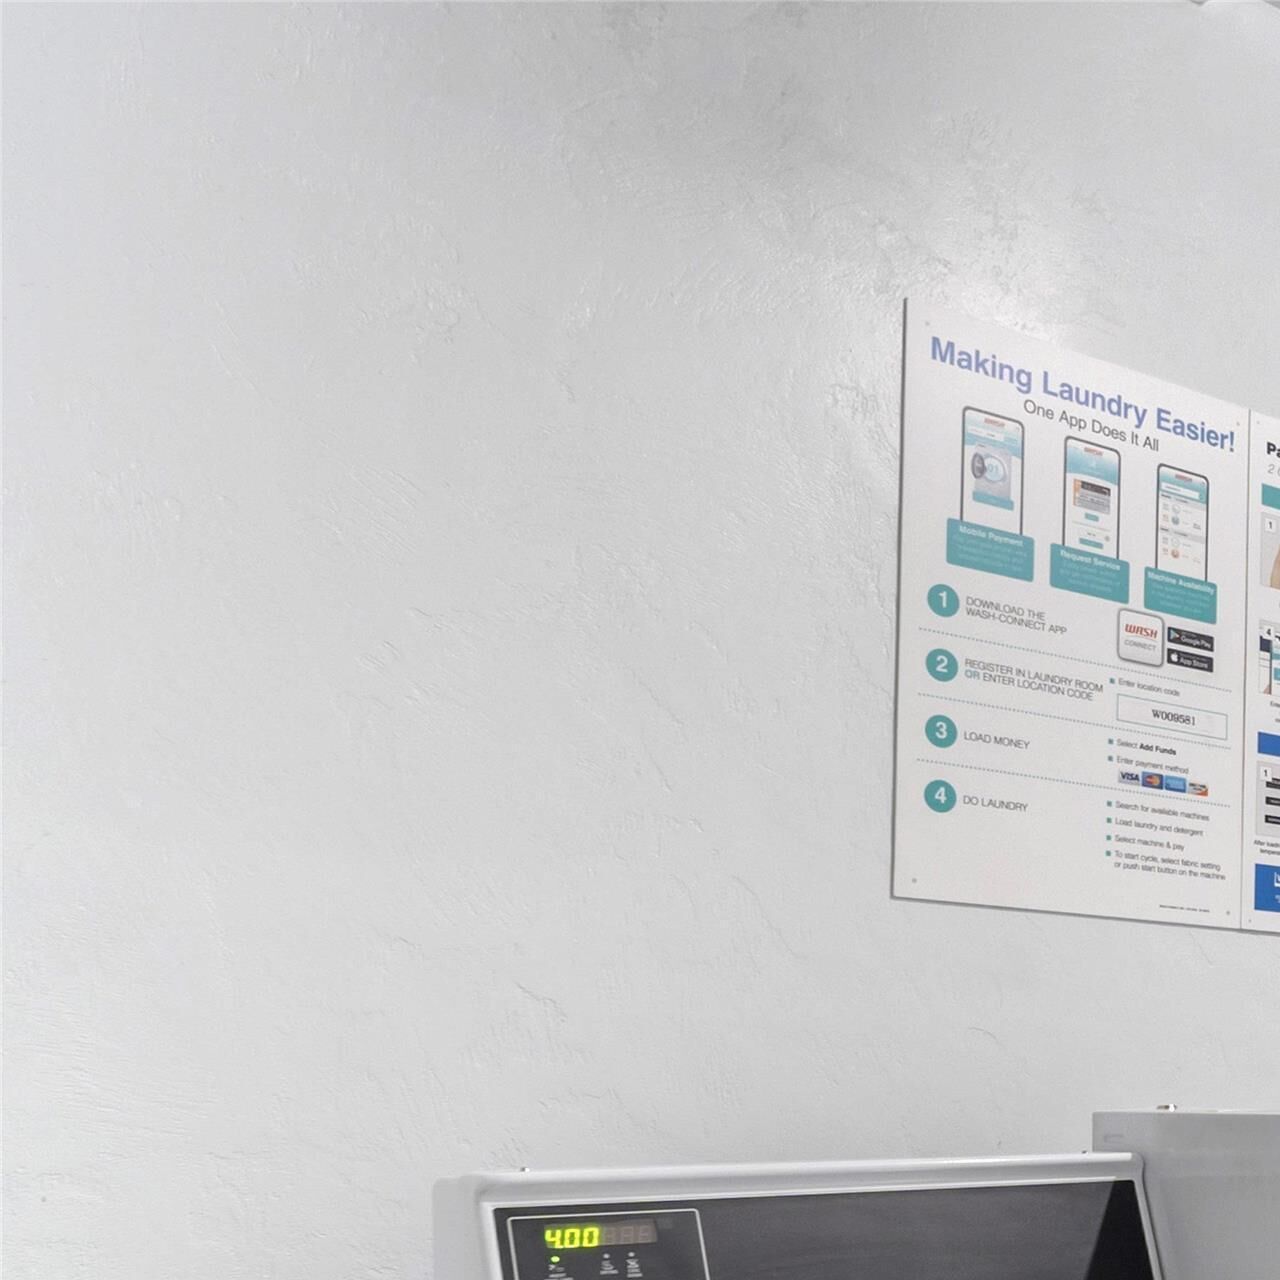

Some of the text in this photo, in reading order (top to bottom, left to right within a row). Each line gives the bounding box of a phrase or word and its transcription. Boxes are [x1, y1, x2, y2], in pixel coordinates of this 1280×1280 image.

[930, 336, 1236, 452] Making Laundry Easier!
[1023, 399, 1159, 451] One App Does It All
[1268, 464, 1274, 474] 2
[960, 525, 1023, 546] Mobile Payment
[938, 591, 947, 608] 1
[966, 596, 1045, 621] DOWNLOAD THE
[966, 607, 1067, 634] WASH-CONNECT APP
[1125, 624, 1157, 639] WASH
[936, 656, 948, 672] 2
[965, 658, 1103, 693] REGISTER IN LAUNDRY ROOM
[964, 669, 1094, 701] OR ENTER LOCATION CODE
[1119, 678, 1180, 696] Enter location code
[1152, 709, 1195, 726] W009581
[936, 722, 947, 739] 3
[964, 731, 1030, 750] LOAD MONEY
[1117, 739, 1138, 749] Select
[1155, 746, 1176, 755] Funds
[1117, 756, 1188, 774] Enter payment method
[1120, 772, 1139, 781] VISA
[934, 787, 947, 803] 4
[963, 795, 1028, 812] DO LAUNDRY
[1116, 801, 1139, 811] Search
[1151, 807, 1178, 817] available
[1180, 811, 1209, 821] machines
[1115, 818, 1133, 827] Load
[1134, 821, 1157, 832] laundry
[1174, 827, 1203, 837] detergent
[1115, 835, 1136, 844] Select
[1137, 837, 1164, 848] machine
[1173, 843, 1185, 852] pay
